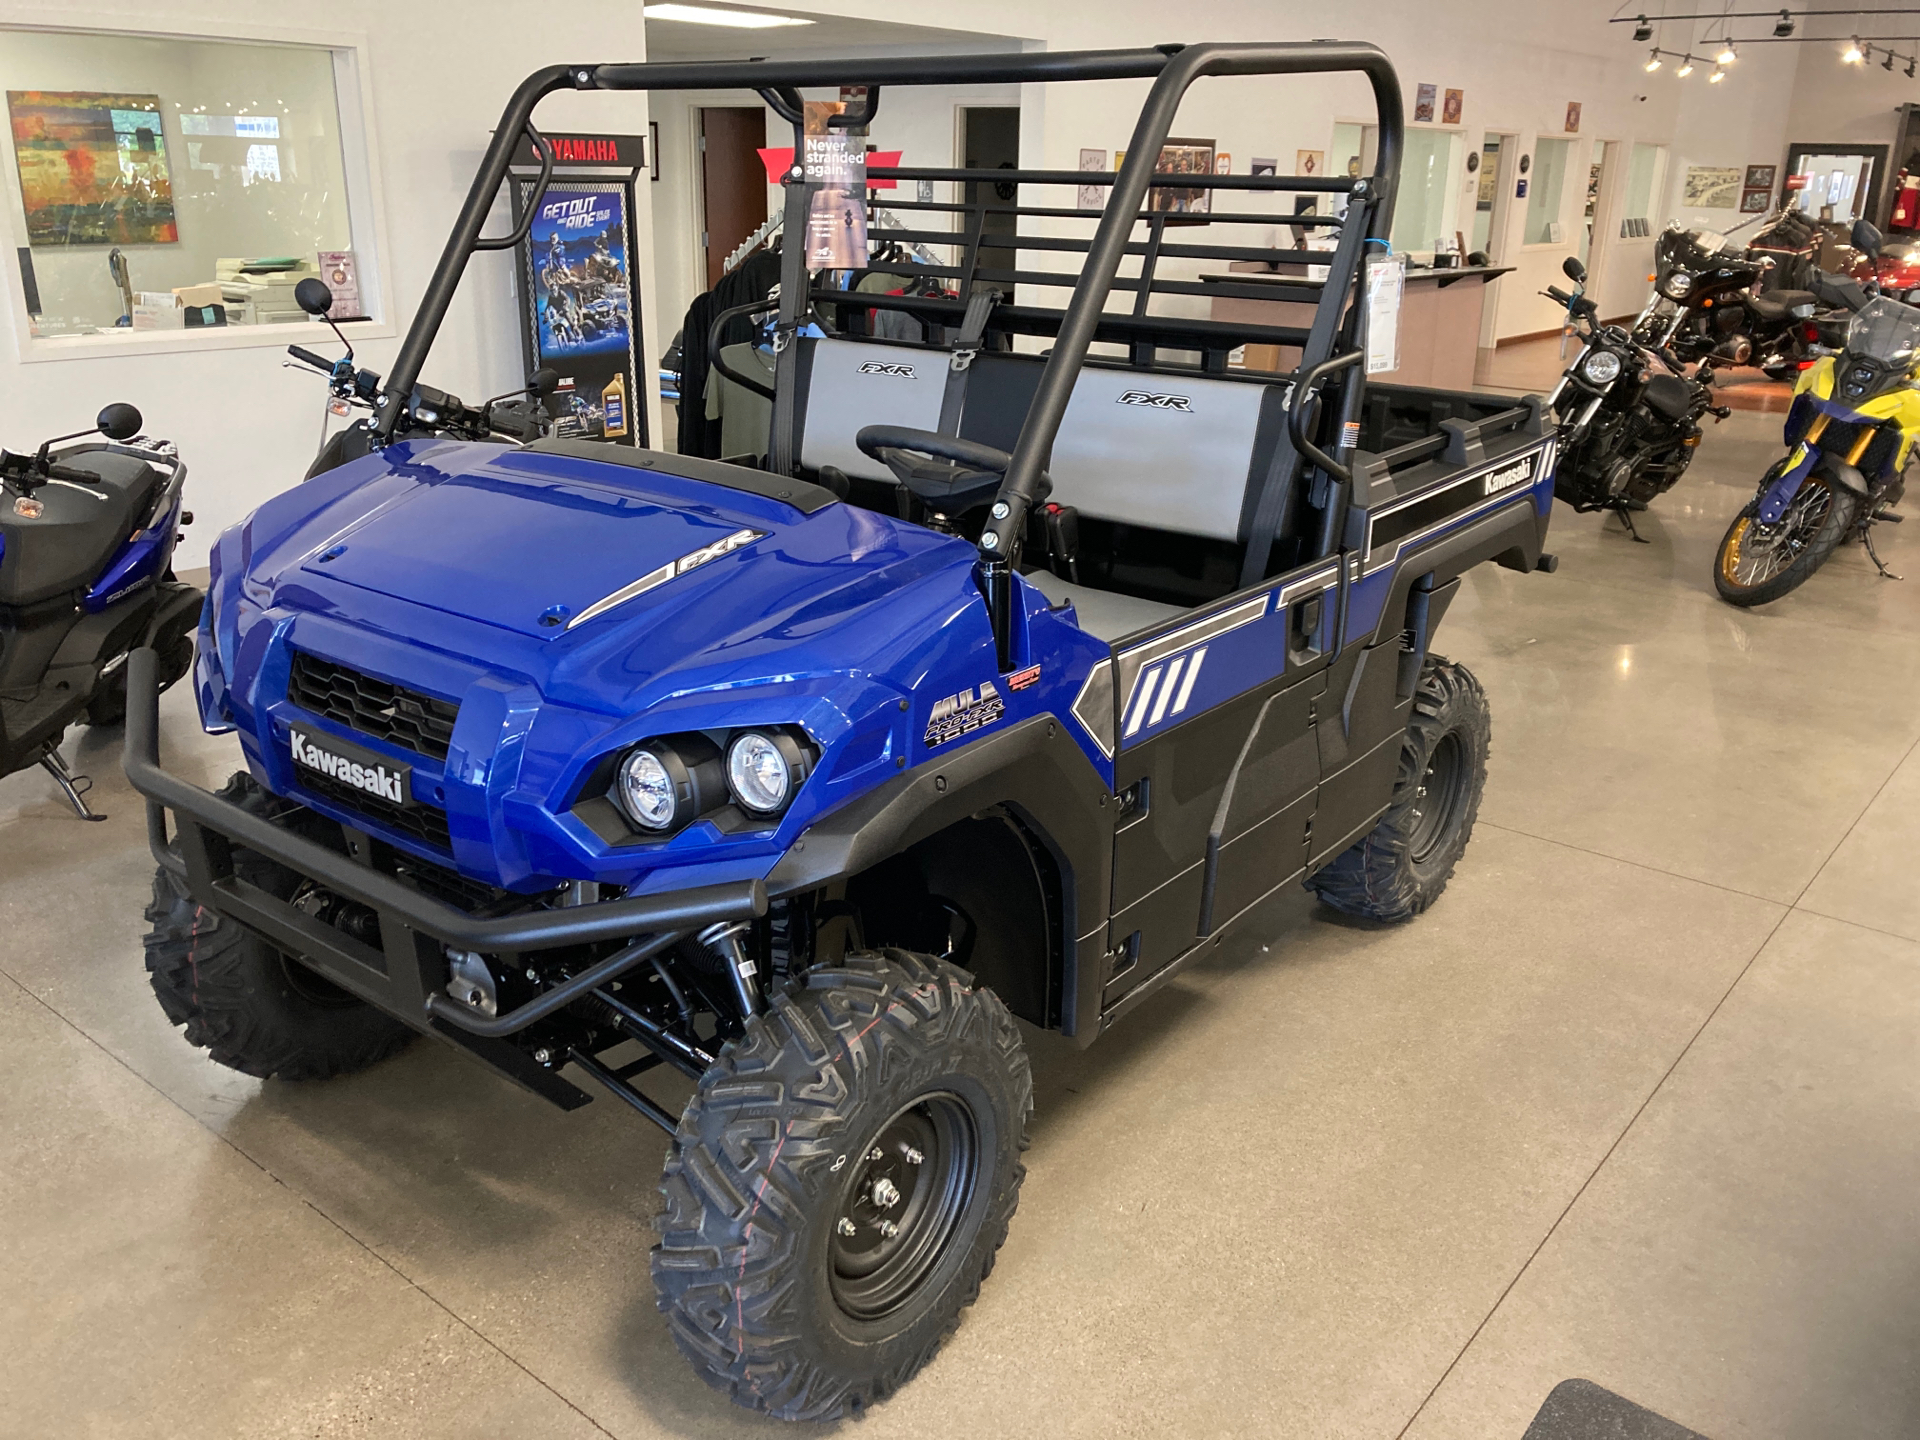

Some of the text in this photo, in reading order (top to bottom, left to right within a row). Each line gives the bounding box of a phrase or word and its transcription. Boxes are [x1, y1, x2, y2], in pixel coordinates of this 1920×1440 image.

[552, 139, 619, 161] YAMAHA
[807, 138, 846, 151] Never
[806, 151, 865, 164] stranded
[806, 163, 848, 178] again.
[542, 196, 597, 220] GET OUT
[565, 211, 596, 229] RIDE
[856, 360, 918, 379] FXR
[1115, 390, 1195, 413] FXR
[1484, 456, 1532, 496] Kawasaki
[677, 528, 763, 575] FXR
[927, 680, 1001, 728] MULE
[924, 698, 1006, 740] PRO-FXR
[289, 729, 403, 804] Kawasaki
